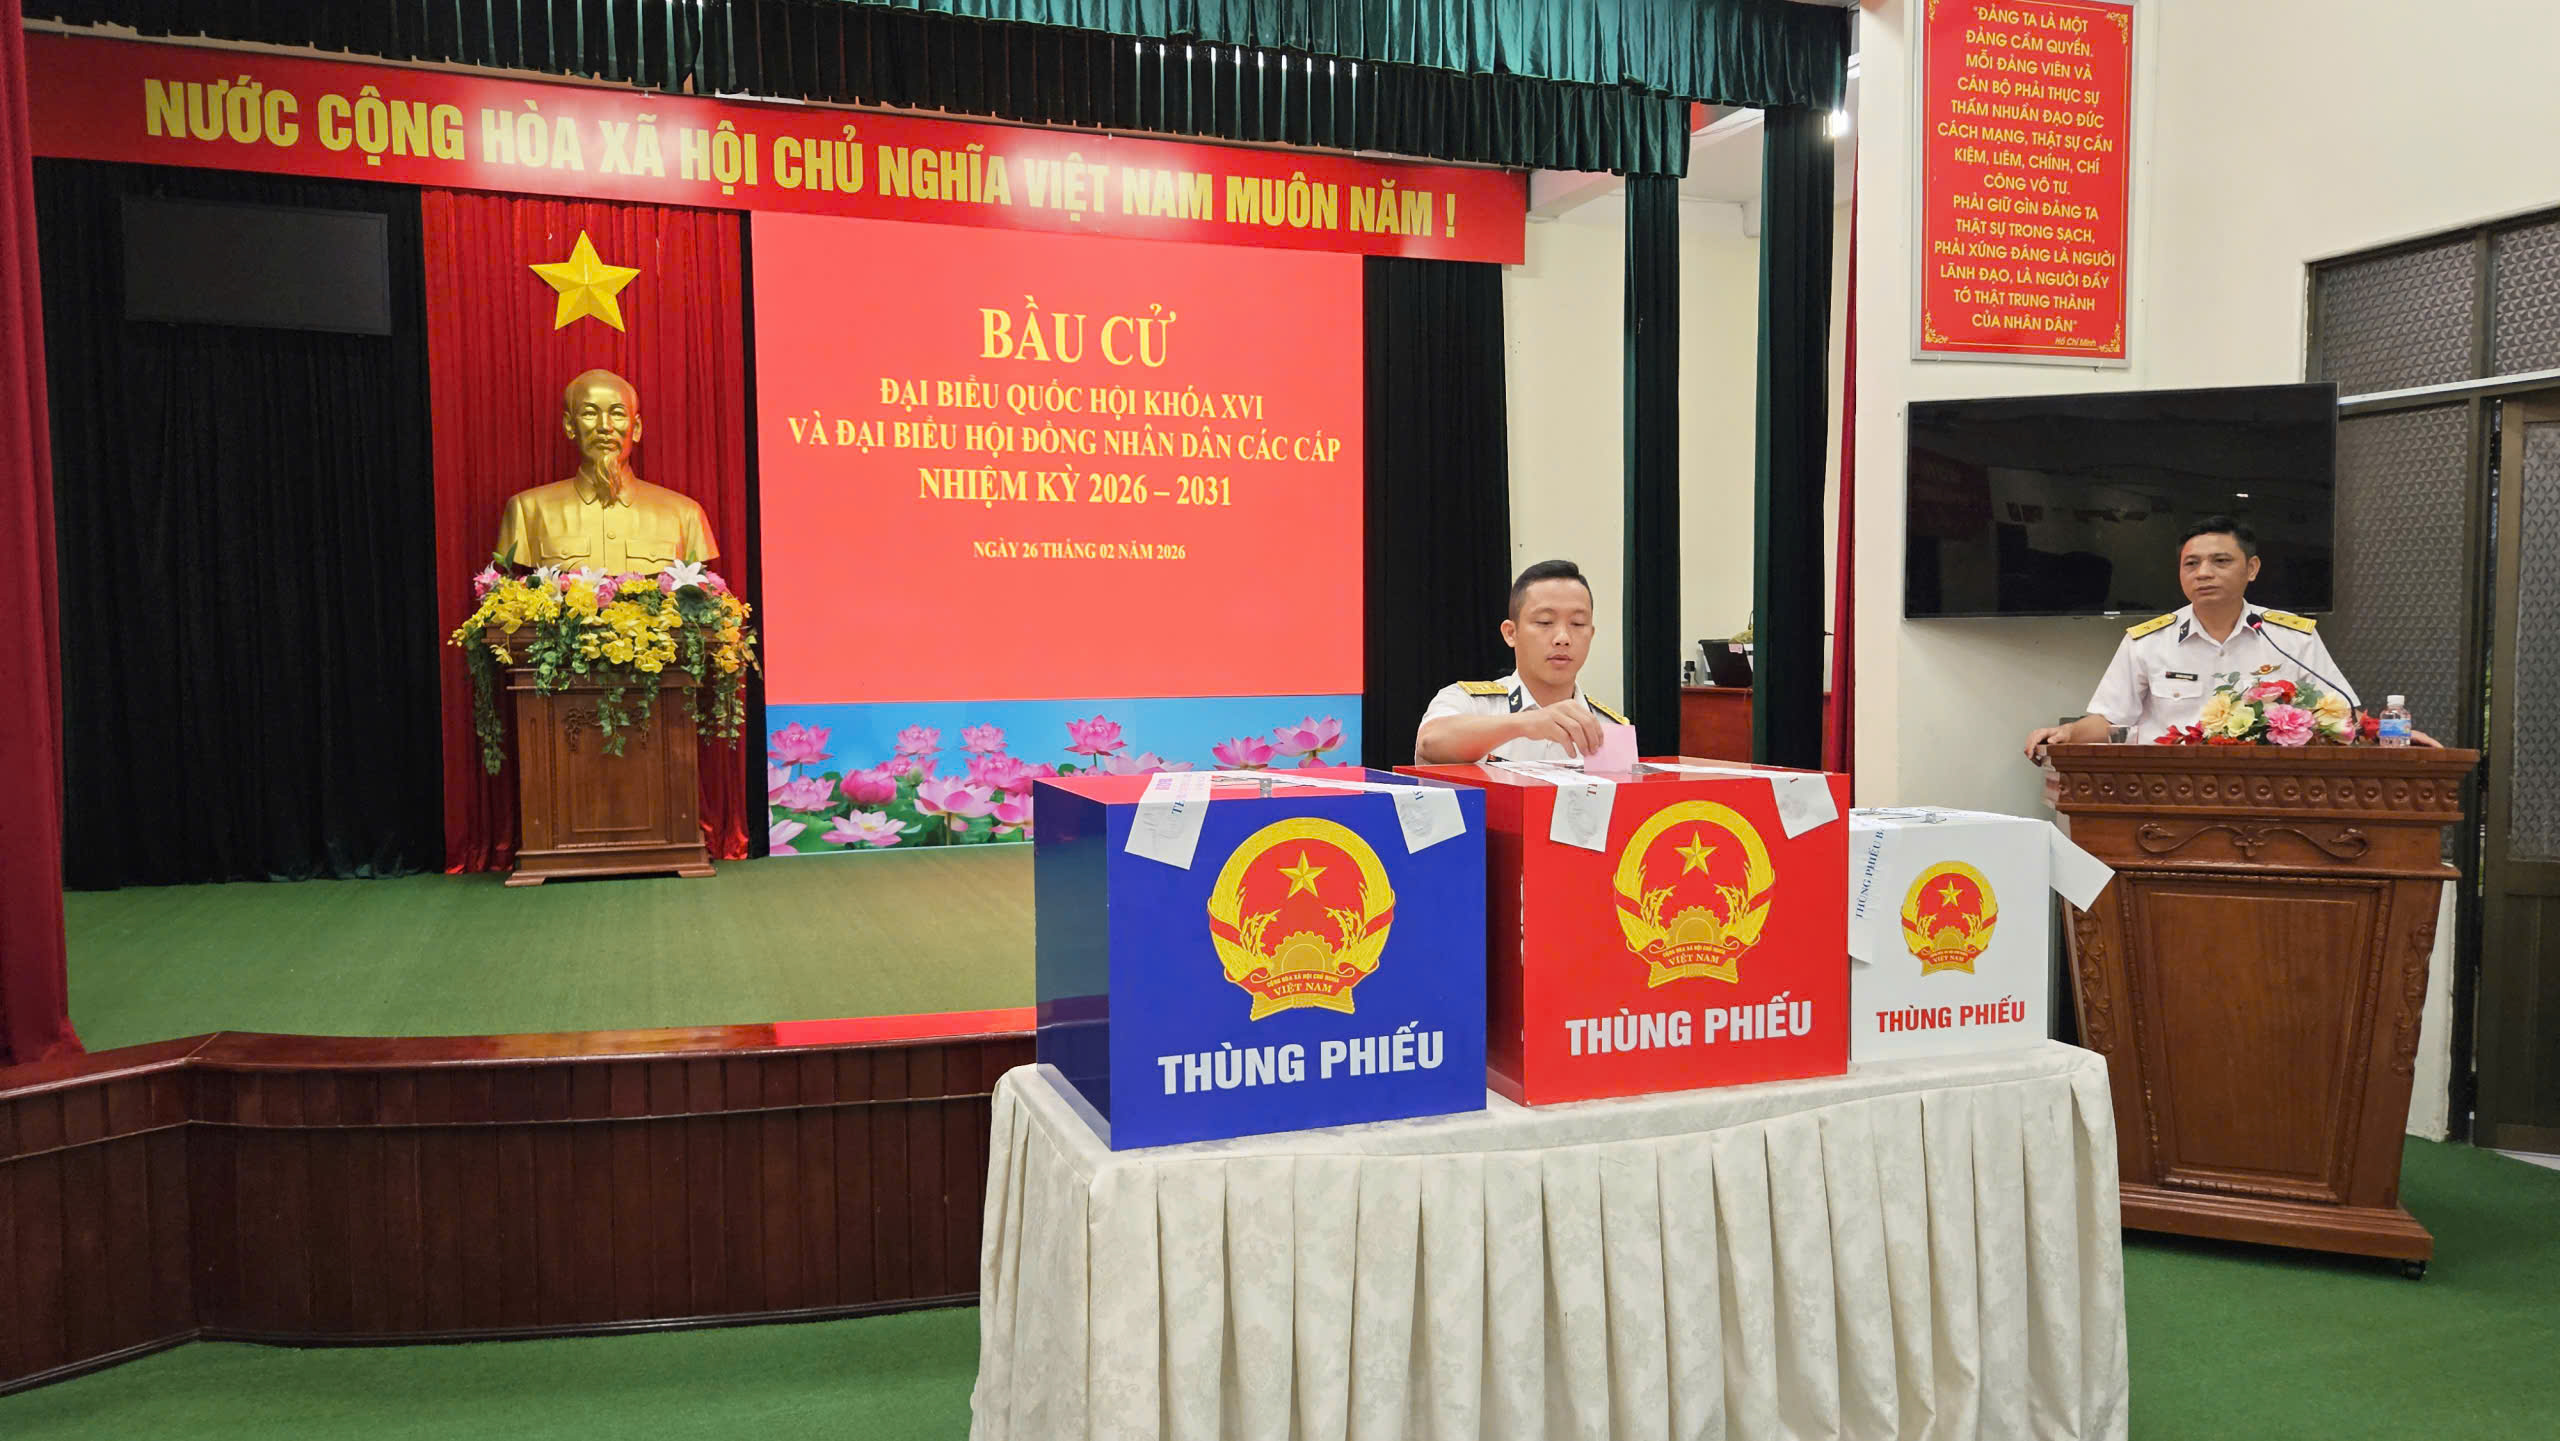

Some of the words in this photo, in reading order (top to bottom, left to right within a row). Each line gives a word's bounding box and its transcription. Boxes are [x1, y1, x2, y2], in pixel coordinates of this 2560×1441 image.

[2023, 12, 2037, 26] TA
[2041, 12, 2056, 29] LÀ
[2060, 16, 2088, 35] MỘT
[1966, 26, 2007, 47] ĐẢNG
[2011, 32, 2043, 51] CẦM
[1966, 49, 1993, 69] MỖI
[1996, 54, 2038, 74] ĐẢNG
[2041, 61, 2070, 78] VIÊN
[2074, 64, 2092, 80] VÀ
[1958, 74, 1988, 92] CÁN
[1992, 78, 2011, 97] BỘ
[2015, 80, 2044, 98] PHẢI
[2048, 86, 2080, 104] THỰC
[2084, 91, 2100, 107] SỰ
[1952, 98, 1988, 116] THẤM
[1992, 103, 2039, 121] NHUẦN
[2042, 110, 2073, 126] ĐẠO
[2076, 111, 2104, 128] ĐỨC
[1938, 120, 1978, 139] CÁCH
[1982, 127, 2028, 145] MẠNG,
[2032, 130, 2062, 149] THẬT
[2065, 135, 2080, 152] SỰ
[2084, 134, 2112, 152] CẦN
[145, 75, 299, 147] NƯỚC
[318, 86, 468, 166] CỘNG
[482, 100, 588, 173] HÒA
[596, 114, 668, 177] XÃ
[678, 117, 757, 198] HỘI
[774, 125, 863, 193] CHỦ
[879, 144, 1010, 208] NGHĨA
[1020, 152, 1110, 221] VIỆT
[1120, 164, 1212, 220] NAM
[1226, 172, 1337, 229] MUÔN
[1350, 179, 1435, 239] NĂM
[1446, 194, 1455, 238] !
[1955, 146, 1989, 165] KIỆM,
[1993, 150, 2024, 168] LIÊM,
[2029, 153, 2072, 173] CHÍNH,
[2077, 158, 2100, 174] CHÍ
[1984, 172, 2026, 190] CÔNG
[2030, 176, 2050, 192] VÔ
[2053, 180, 2070, 194] TƯ.
[1954, 192, 1983, 210] PHẢI
[1987, 196, 2012, 212] GIỮ
[2014, 197, 2038, 214] GÌN
[2042, 200, 2082, 218] ĐẢNG
[2085, 207, 2098, 219] TA
[1956, 217, 1987, 236] THẬT
[1990, 222, 2006, 238] SỰ
[2009, 223, 2053, 239] TRONG
[2057, 227, 2095, 243] SẠCH,
[1935, 238, 1964, 255] PHẢI
[1969, 240, 2007, 258] XỨNG
[2010, 244, 2050, 262] ĐÁNG
[2054, 247, 2069, 263] LÀ
[2073, 250, 2115, 266] NGƯỜI
[1941, 263, 1975, 279] LÃNH
[1979, 268, 2013, 284] ĐẠO,
[2017, 267, 2032, 283] LÀ
[2036, 270, 2078, 287] NGƯỜI
[2082, 272, 2109, 288] ĐẦY
[1954, 286, 1971, 303] TỚ
[1975, 289, 2005, 307] THẬT
[2008, 293, 2050, 308] TRUNG
[2053, 293, 2095, 310] THÀNH
[980, 295, 1086, 363] BẦU
[1101, 304, 1176, 367] CỬ
[1972, 310, 2000, 327] CỦA
[2004, 314, 2041, 330] NHÂN
[880, 378, 928, 410] ĐẠI
[937, 375, 998, 408] BIỂU
[1007, 379, 1082, 415] QUỐC
[1090, 385, 1136, 420] HỘI
[1144, 385, 1216, 417] KHÓA
[1222, 394, 1262, 419] XVI
[788, 411, 828, 445] VÀ
[836, 420, 884, 451] ĐẠI
[894, 416, 956, 449] BIỂU
[966, 422, 1014, 458] HỘI
[1022, 421, 1096, 454] ĐỒNG
[1104, 424, 1173, 456] NHÂN
[1182, 426, 1231, 458] DÂN
[1238, 428, 1288, 460] CÁC
[1294, 431, 1340, 462] CẤP
[919, 465, 1027, 508] NHIỆM
[1036, 465, 1080, 502] KỲ
[1089, 473, 1147, 503] 2026
[1177, 476, 1230, 505] 2031
[974, 538, 1018, 558] NGÀY
[1023, 543, 1038, 558] 26
[1041, 539, 1096, 558] THÁNG
[1100, 544, 1114, 558] 02
[1119, 541, 1152, 559] NĂM
[1157, 544, 1185, 559] 2026
[1669, 952, 1693, 965] VIỆT
[1696, 953, 1719, 964] NAM
[1273, 982, 1302, 996] VIỆT
[1305, 982, 1333, 992] NAM
[1565, 1008, 1691, 1056] THÙNG
[1705, 991, 1811, 1043] PHIẾU
[1876, 1005, 1951, 1032] THÙNG
[1960, 995, 2024, 1026] PHIẾU
[1158, 1042, 1304, 1094] THÙNG
[1321, 1021, 1443, 1079] PHIẾU
